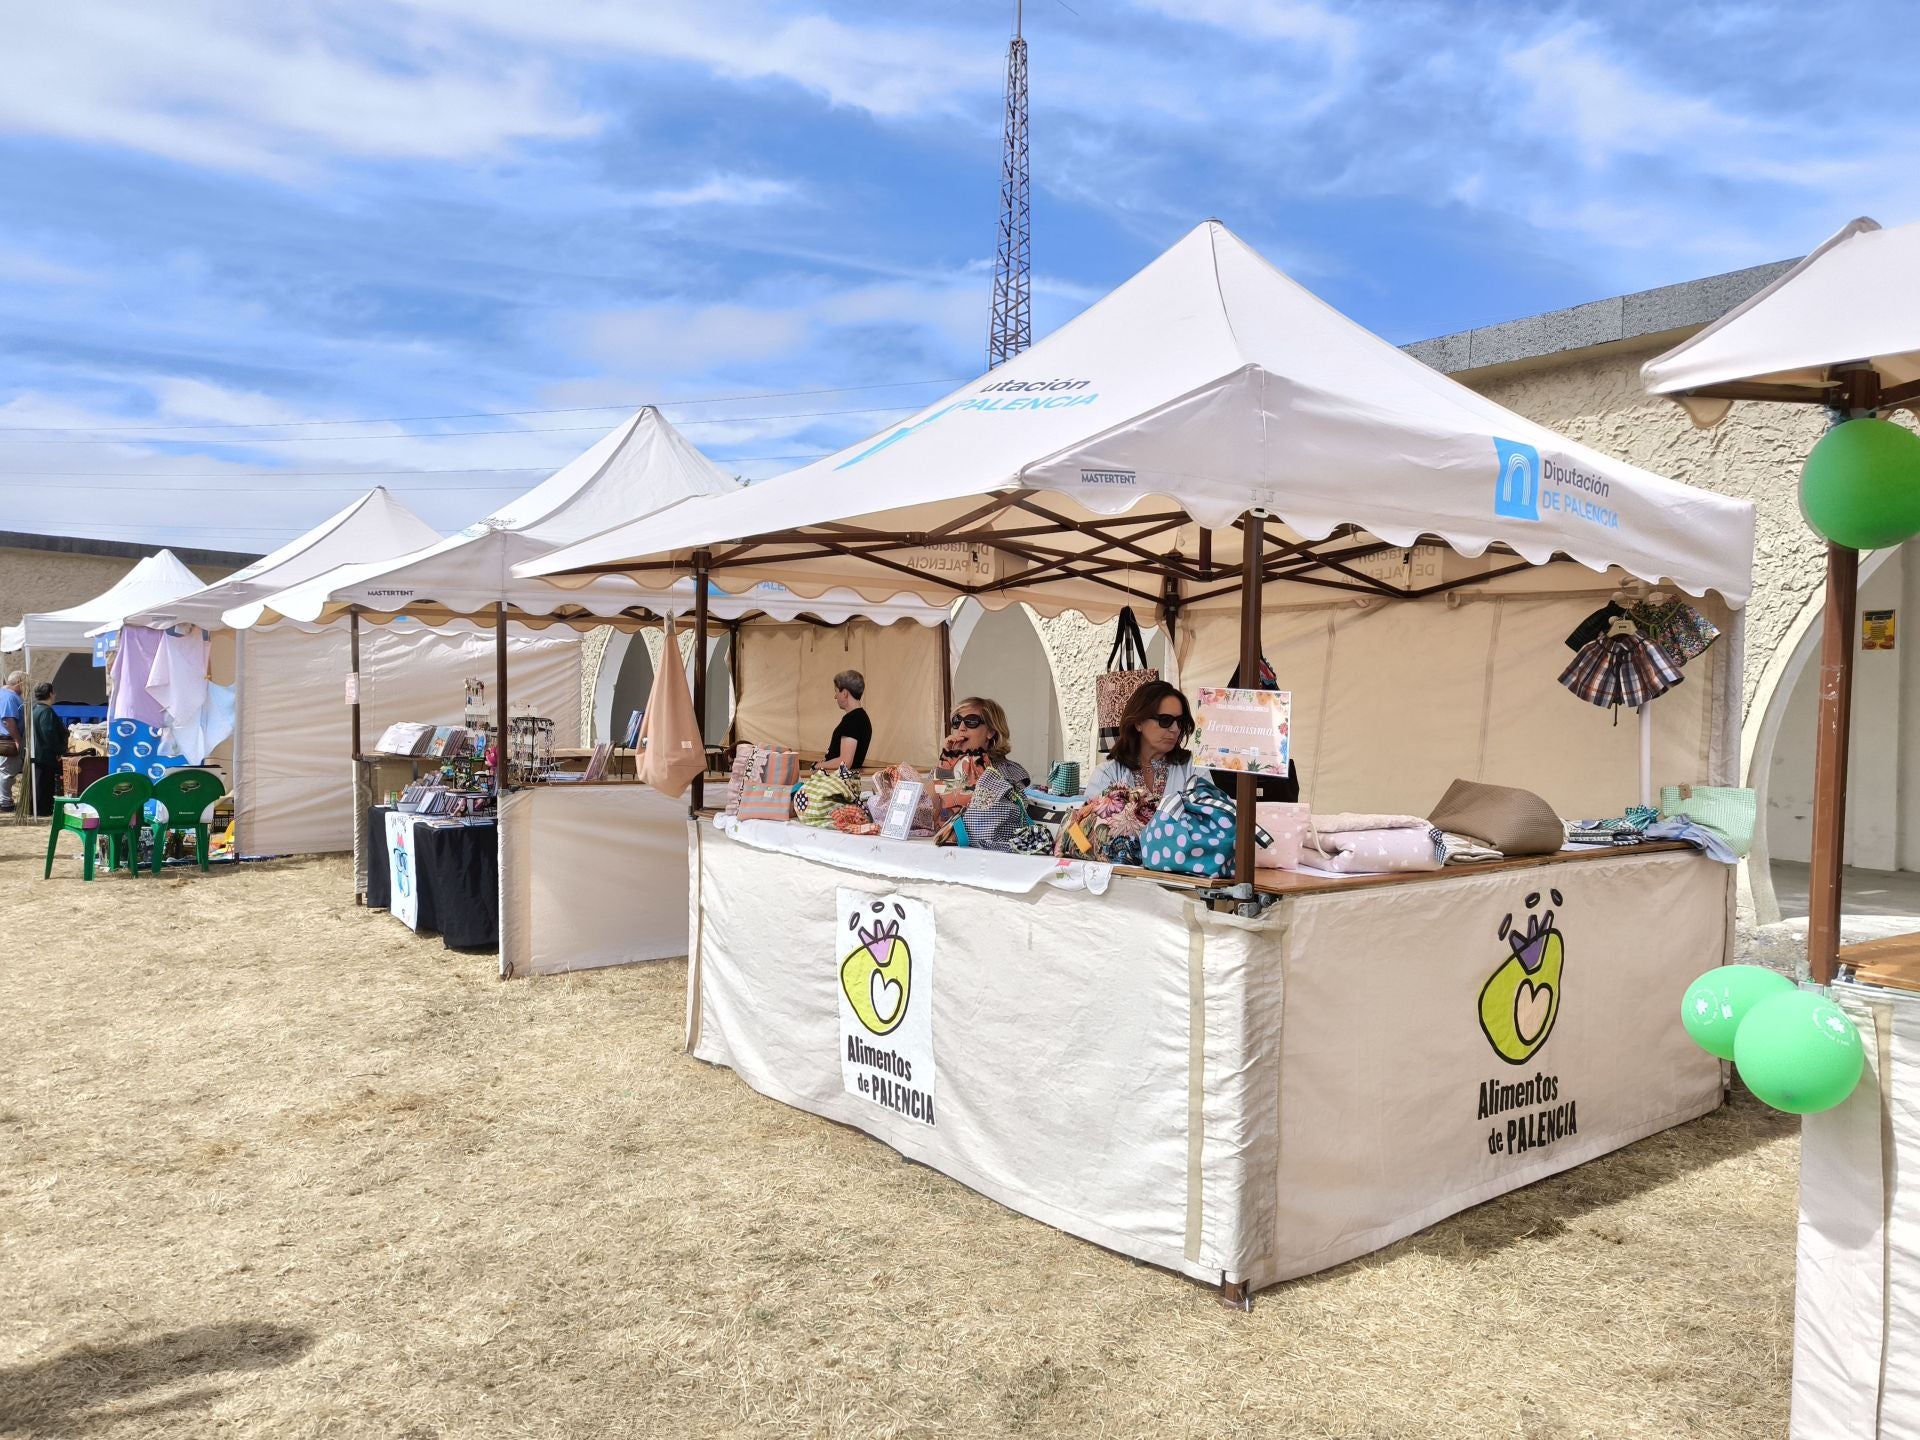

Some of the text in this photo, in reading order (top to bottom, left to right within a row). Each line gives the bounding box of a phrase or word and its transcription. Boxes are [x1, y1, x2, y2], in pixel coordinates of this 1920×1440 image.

[1543, 459, 1610, 498] Diputación
[1542, 490, 1619, 528] DE PALENCIA
[847, 1034, 912, 1082] Alimentos
[857, 1072, 935, 1125] de PALENCIA
[1477, 1071, 1559, 1121] Alimentos
[1488, 1100, 1577, 1155] de PALENCIA
